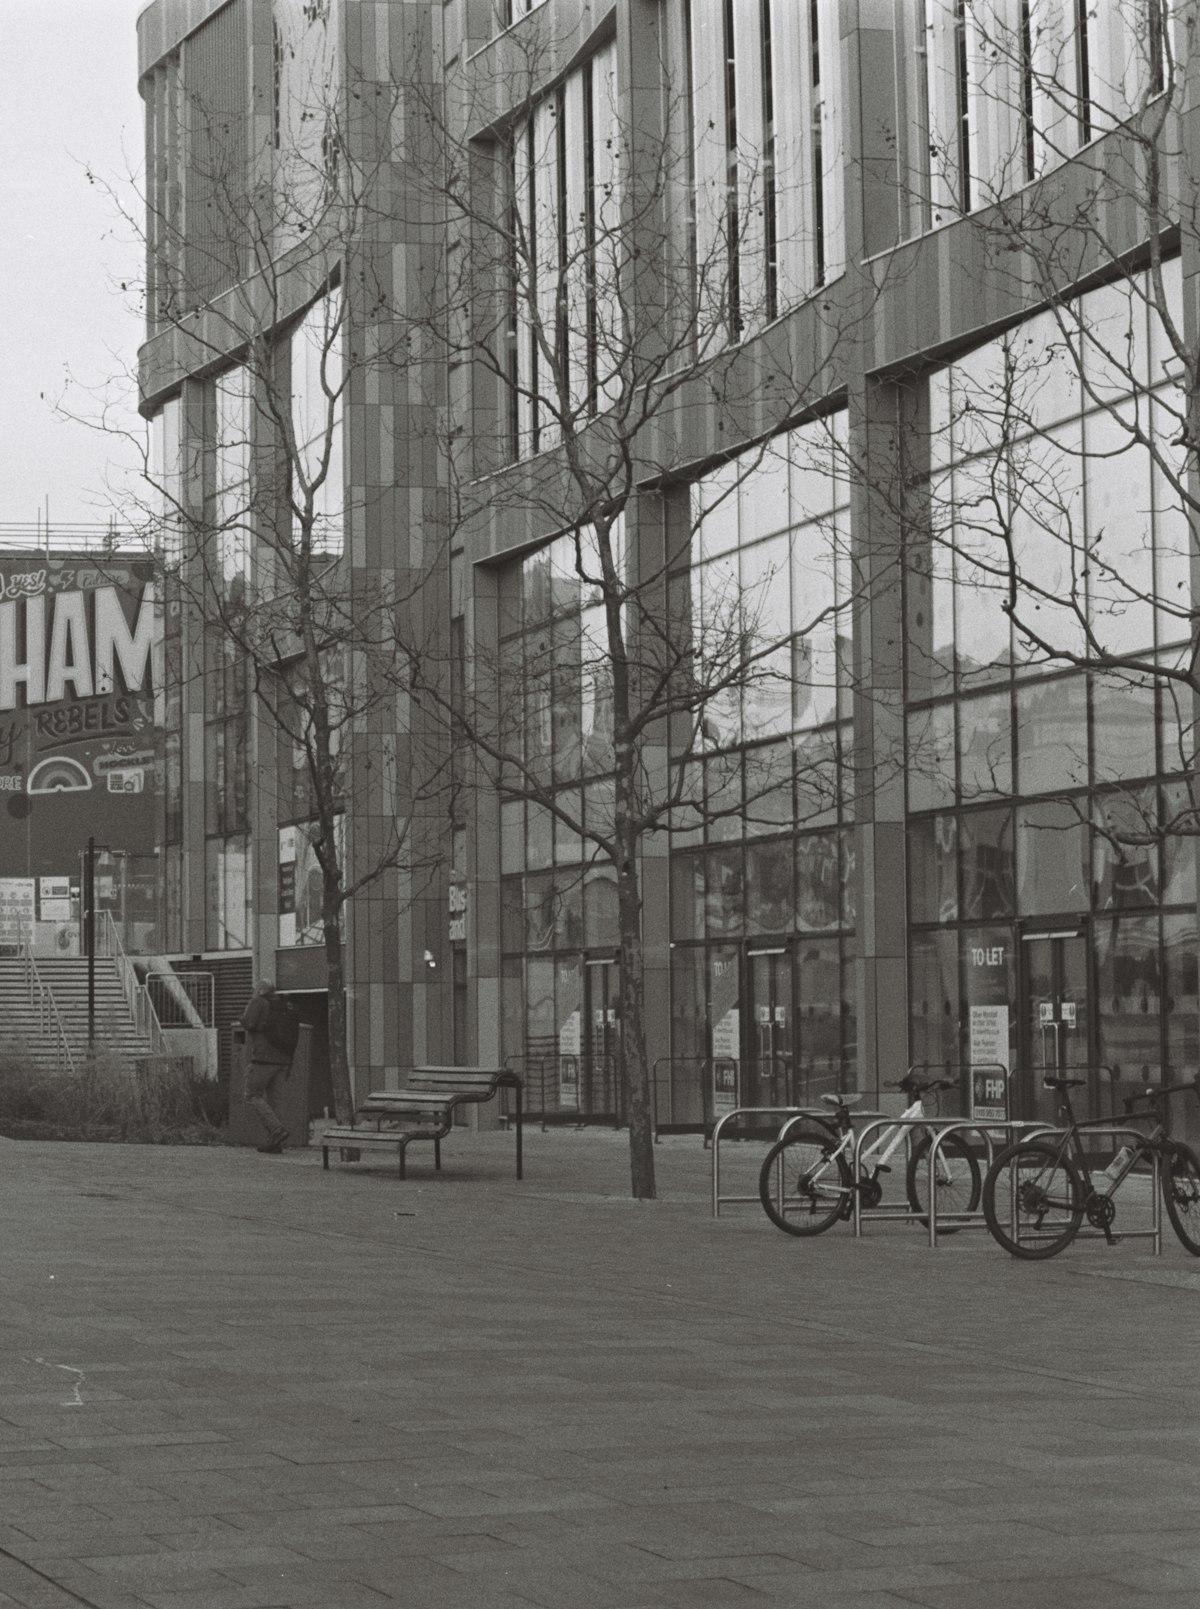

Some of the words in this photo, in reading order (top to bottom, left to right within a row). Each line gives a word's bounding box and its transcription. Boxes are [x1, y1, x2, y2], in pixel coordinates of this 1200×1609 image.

[32, 697, 132, 738] REBELS
[449, 886, 466, 911] Bus
[971, 947, 985, 966] TO
[986, 946, 1004, 966] LET
[985, 1079, 1006, 1099] FHP
